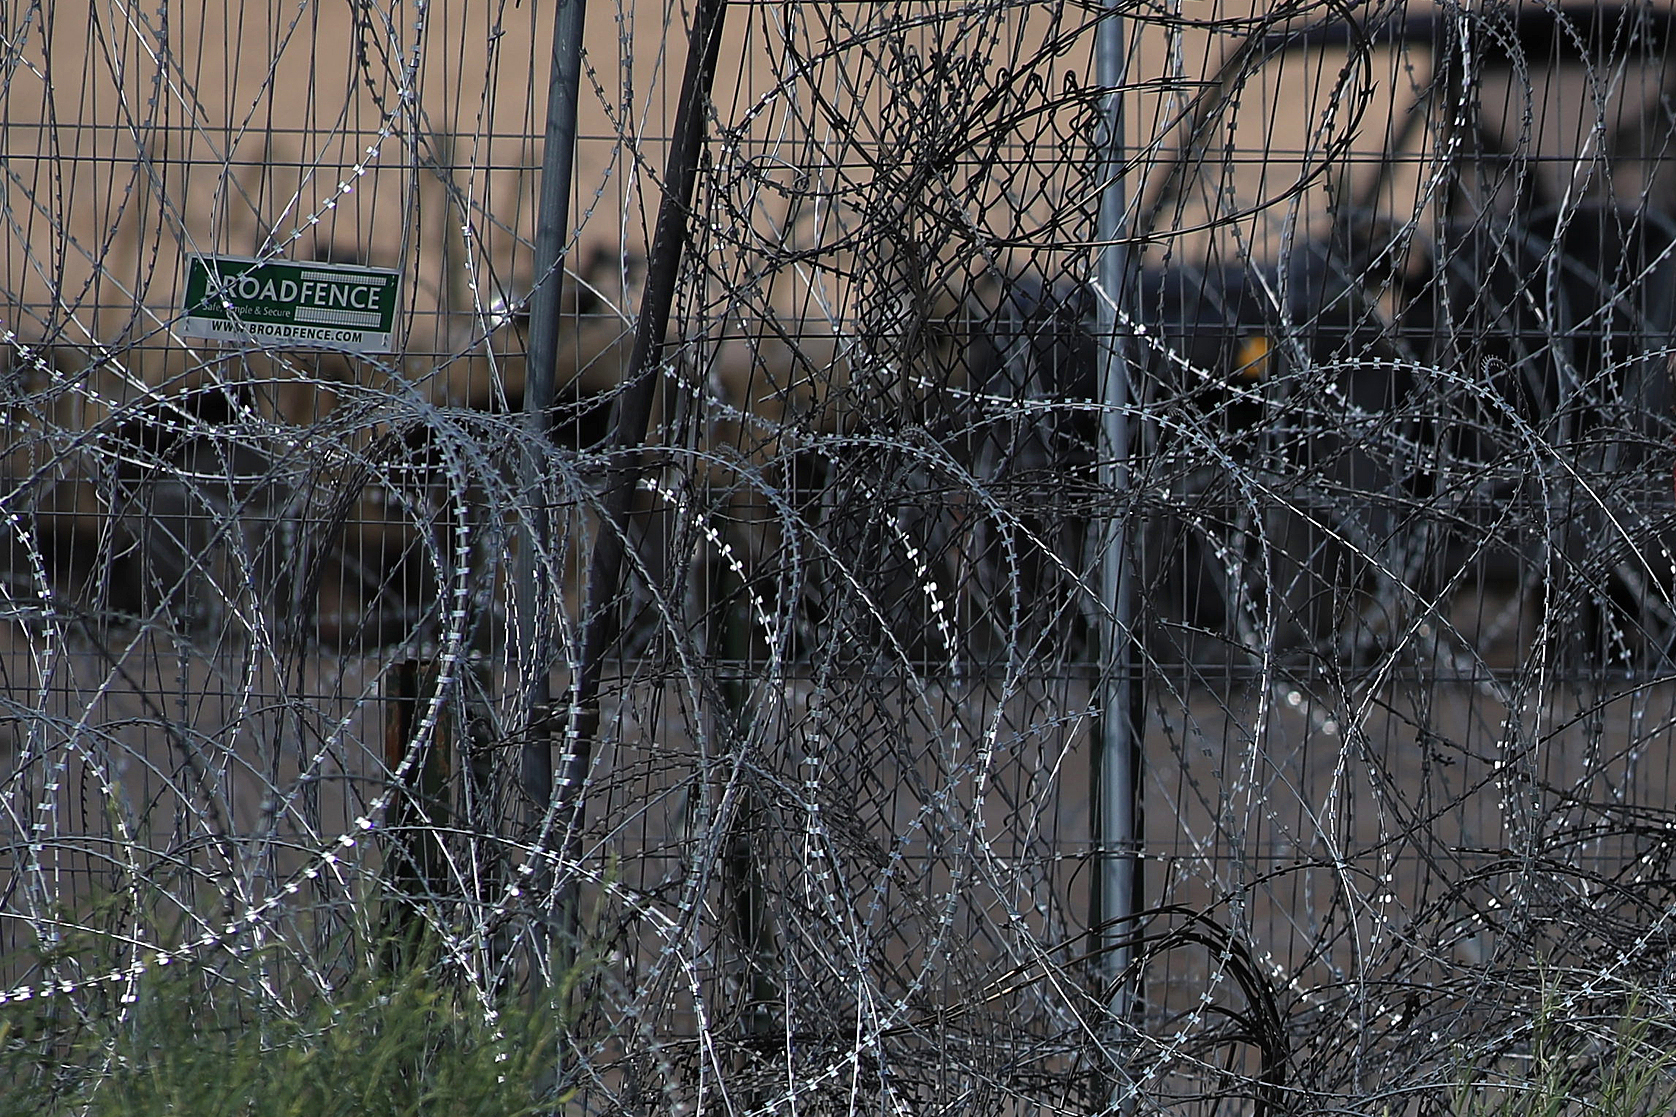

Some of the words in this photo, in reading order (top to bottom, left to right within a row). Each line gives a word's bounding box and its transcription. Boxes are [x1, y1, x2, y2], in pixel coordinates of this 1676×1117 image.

[224, 303, 253, 316] mple
[254, 307, 262, 316] &
[263, 306, 291, 318] Secure
[211, 320, 362, 343] WWWBROADFENCE.COM
